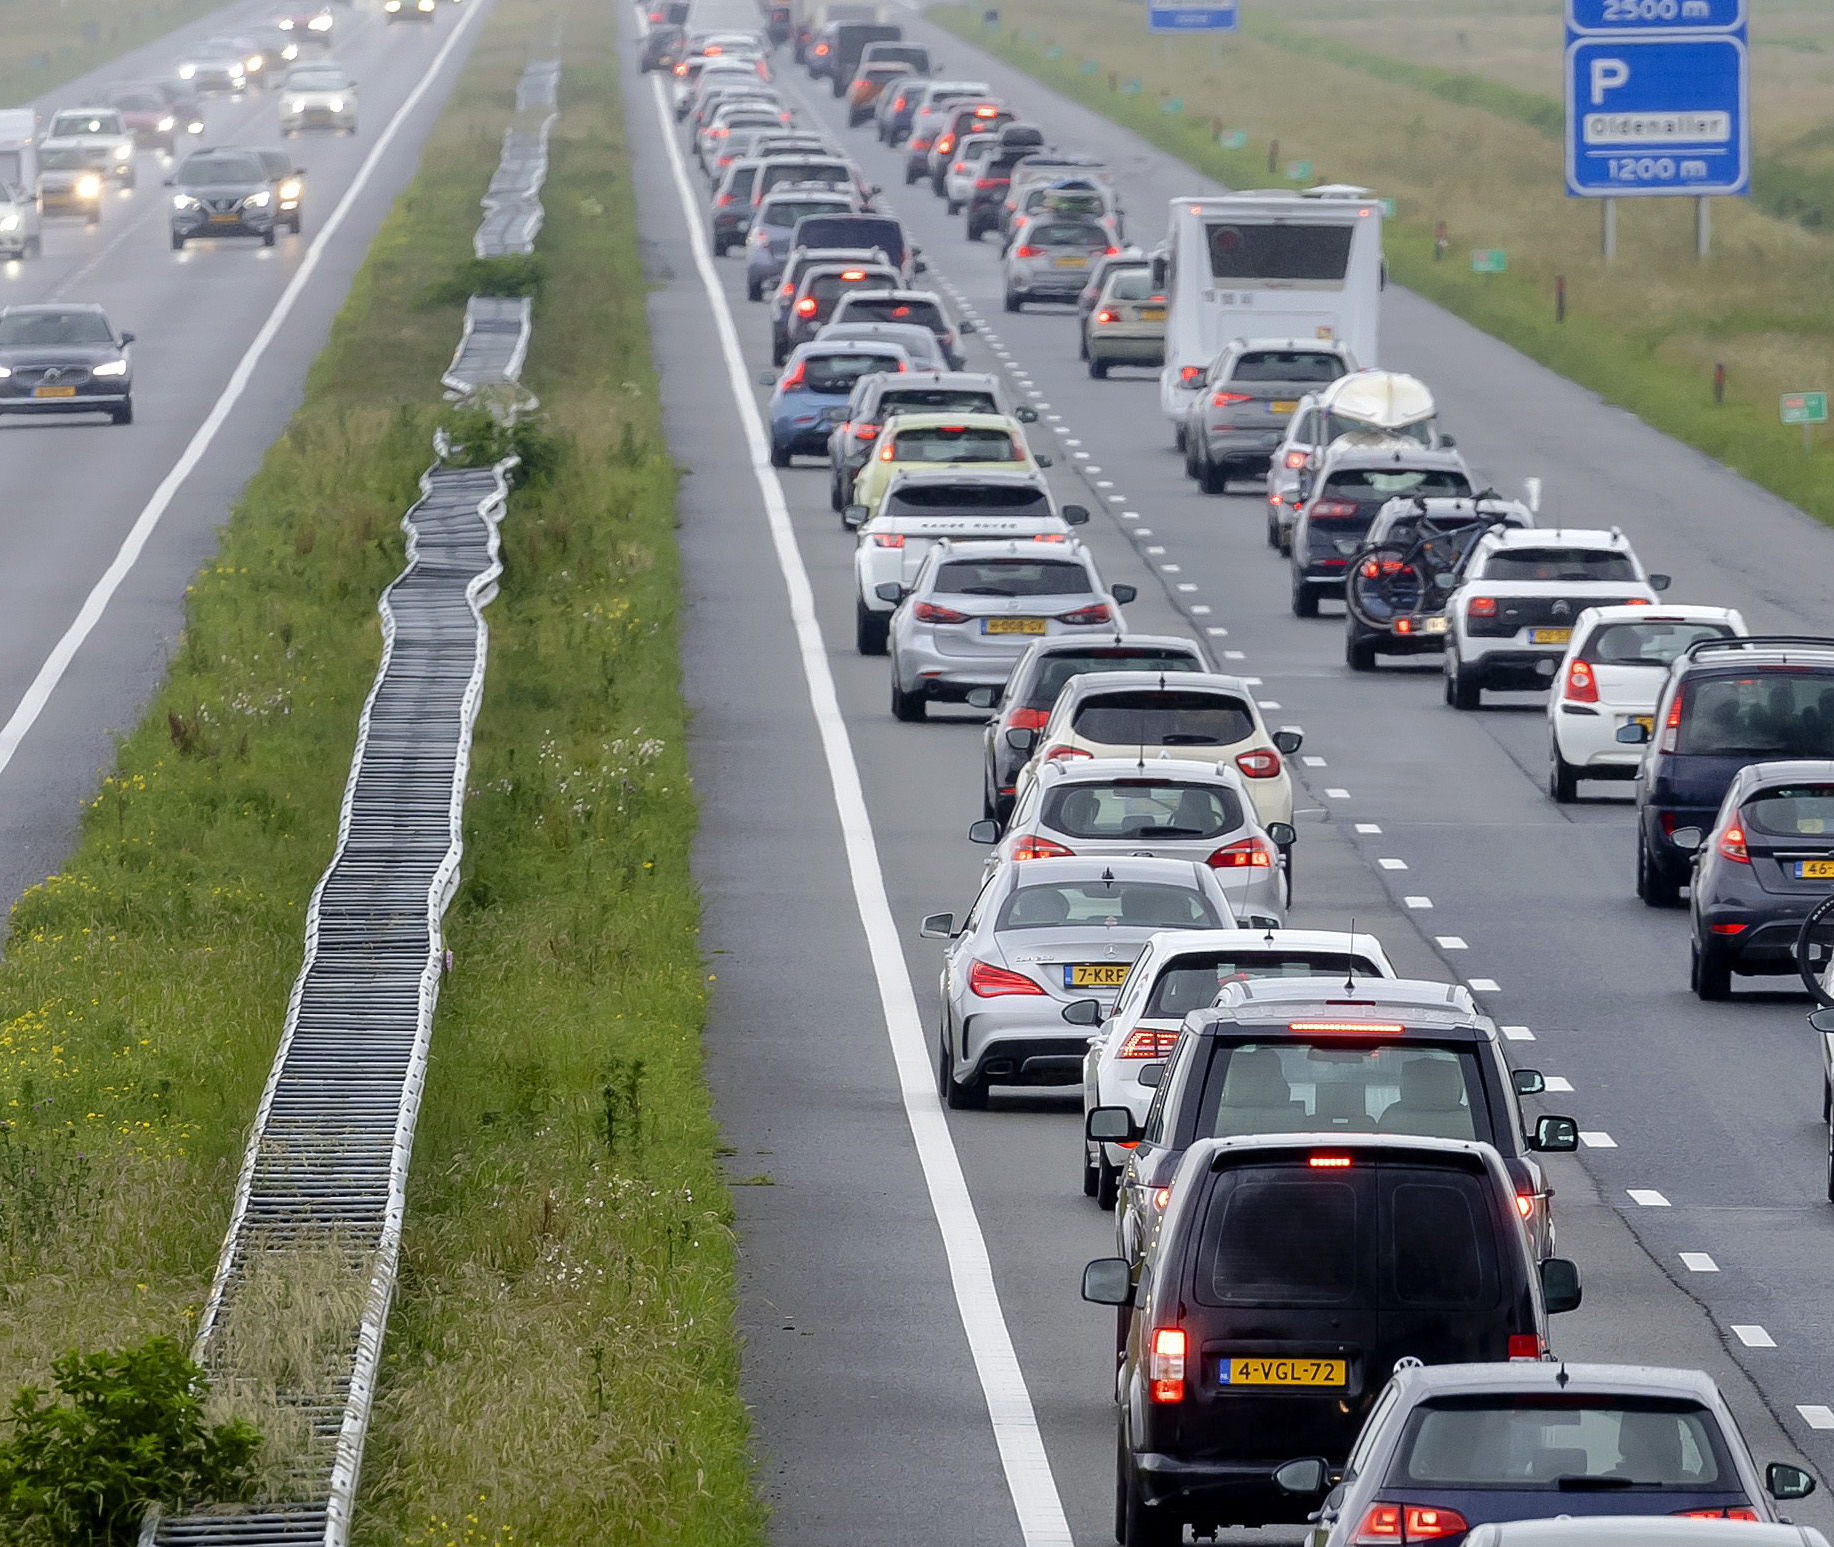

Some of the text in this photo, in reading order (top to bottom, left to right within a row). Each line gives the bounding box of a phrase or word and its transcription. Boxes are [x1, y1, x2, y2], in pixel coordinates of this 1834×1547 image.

[1603, 0, 1710, 20] 2500 m
[1591, 59, 1630, 105] P
[1591, 116, 1722, 137] Oldenaller
[1608, 159, 1707, 180] 1200 m
[1238, 1362, 1335, 1381] 4-VGL-72
